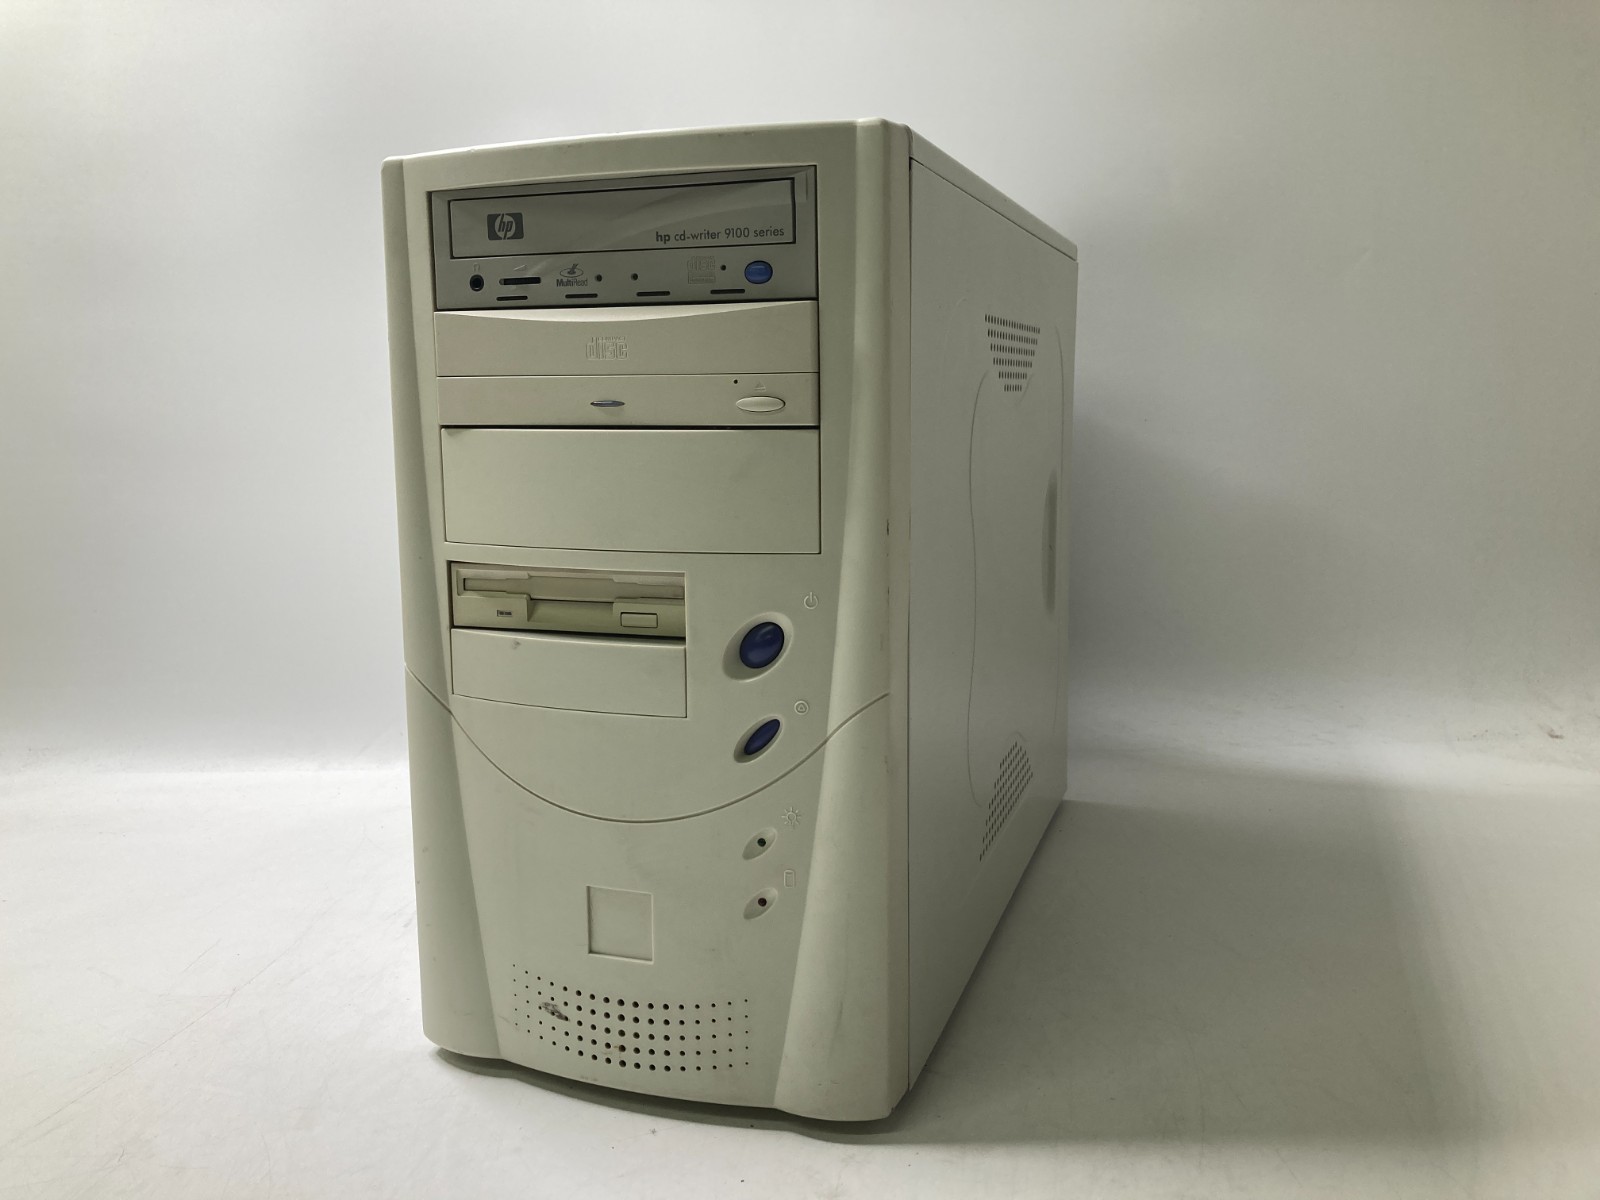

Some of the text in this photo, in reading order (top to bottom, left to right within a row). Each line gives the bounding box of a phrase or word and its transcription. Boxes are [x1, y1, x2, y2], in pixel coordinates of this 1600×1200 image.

[655, 226, 785, 244] hp cd-writer 9100 series
